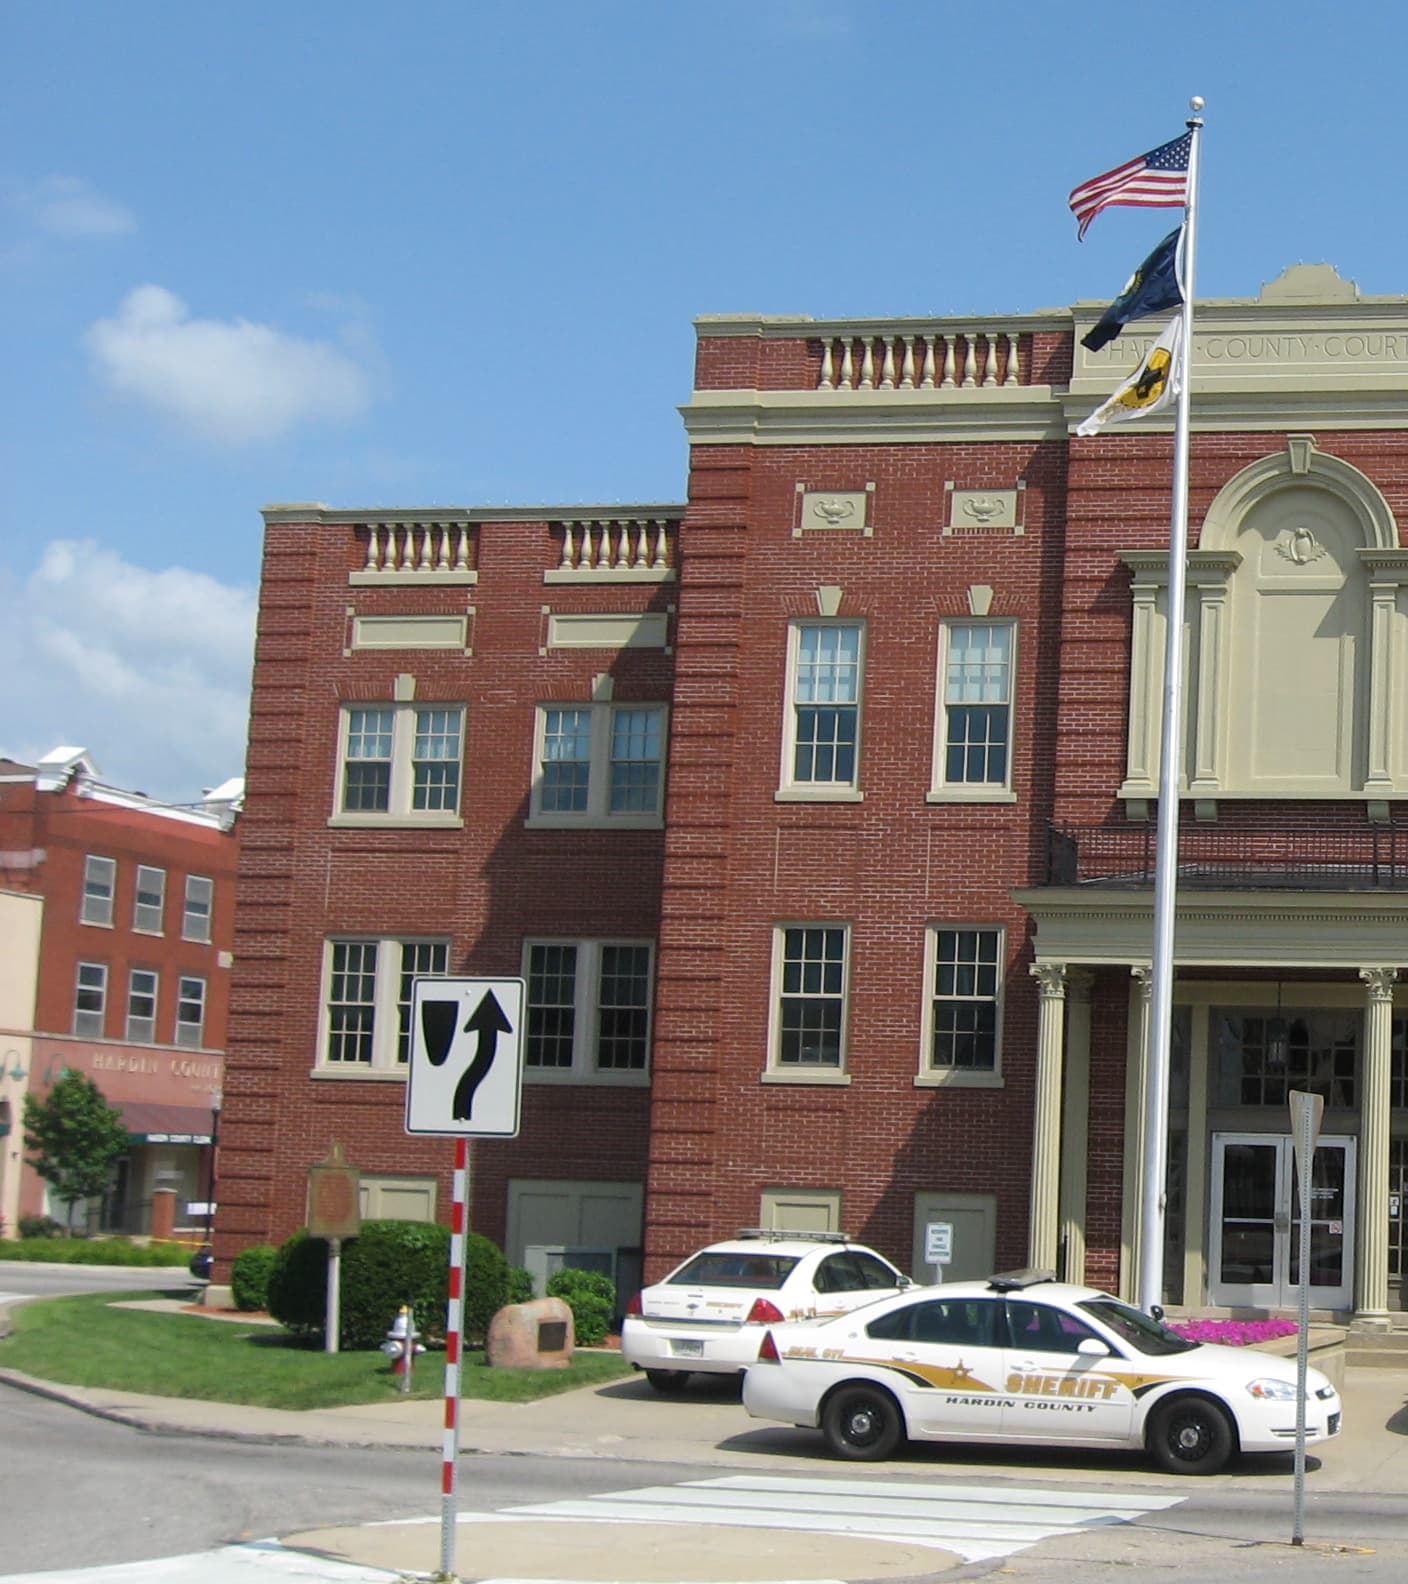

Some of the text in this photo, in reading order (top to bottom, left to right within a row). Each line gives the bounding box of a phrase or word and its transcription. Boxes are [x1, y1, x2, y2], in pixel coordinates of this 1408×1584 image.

[1205, 336, 1313, 359] COUNTY
[170, 1059, 221, 1079] COUNT
[1004, 1372, 1120, 1400] SHERIFF
[945, 1397, 1098, 1413] HARDIN COUNTY
